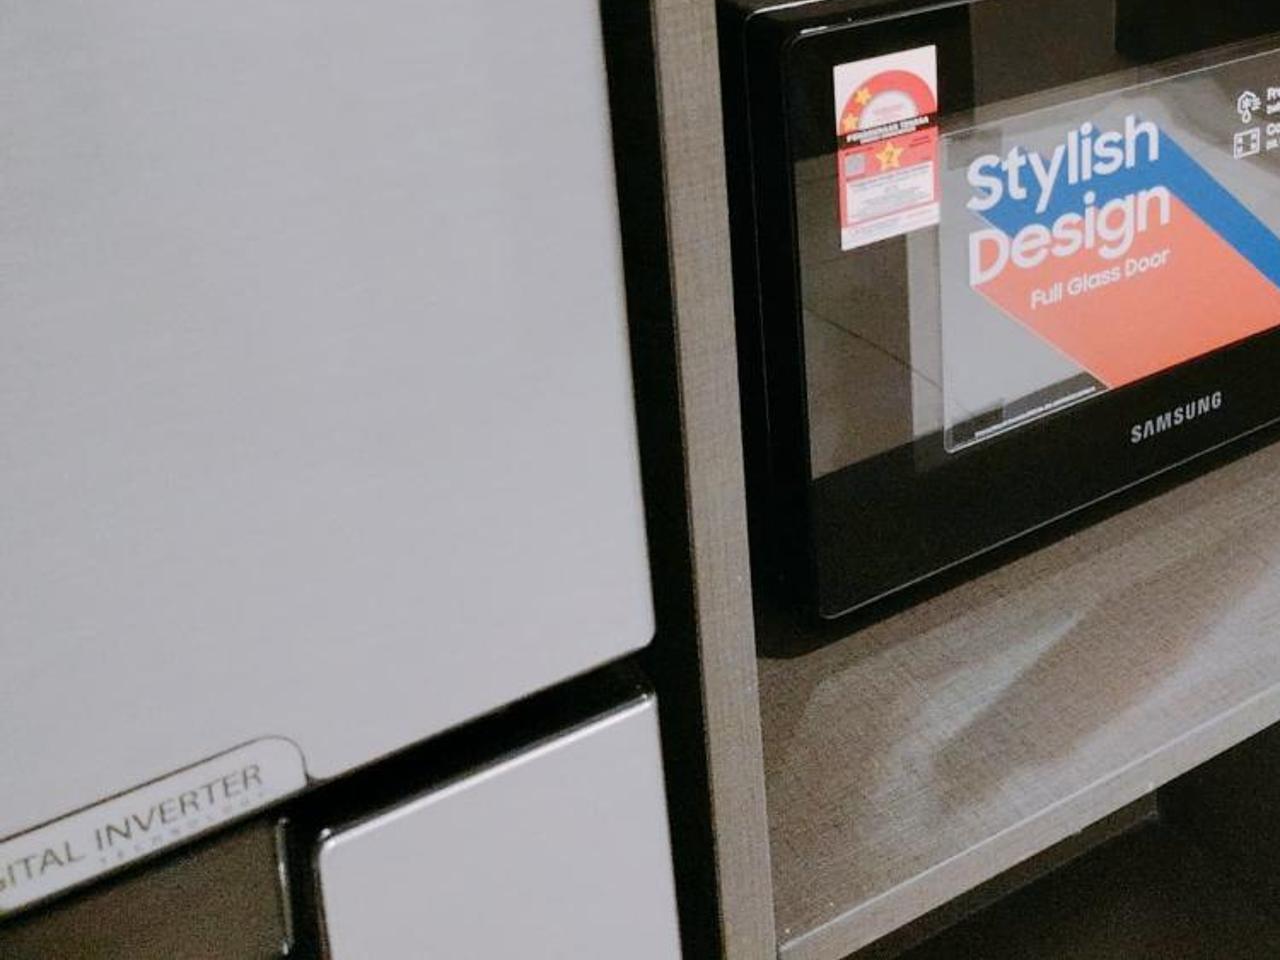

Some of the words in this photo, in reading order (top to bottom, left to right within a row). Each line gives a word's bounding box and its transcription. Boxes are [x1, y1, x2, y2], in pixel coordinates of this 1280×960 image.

[966, 113, 1160, 214] Stylish
[969, 185, 1171, 288] Design
[1030, 282, 1063, 310] Full
[1067, 266, 1121, 296] Glass
[1124, 248, 1171, 279] Door
[1130, 391, 1222, 444] SAMSUNG
[96, 763, 262, 851] INVERTER
